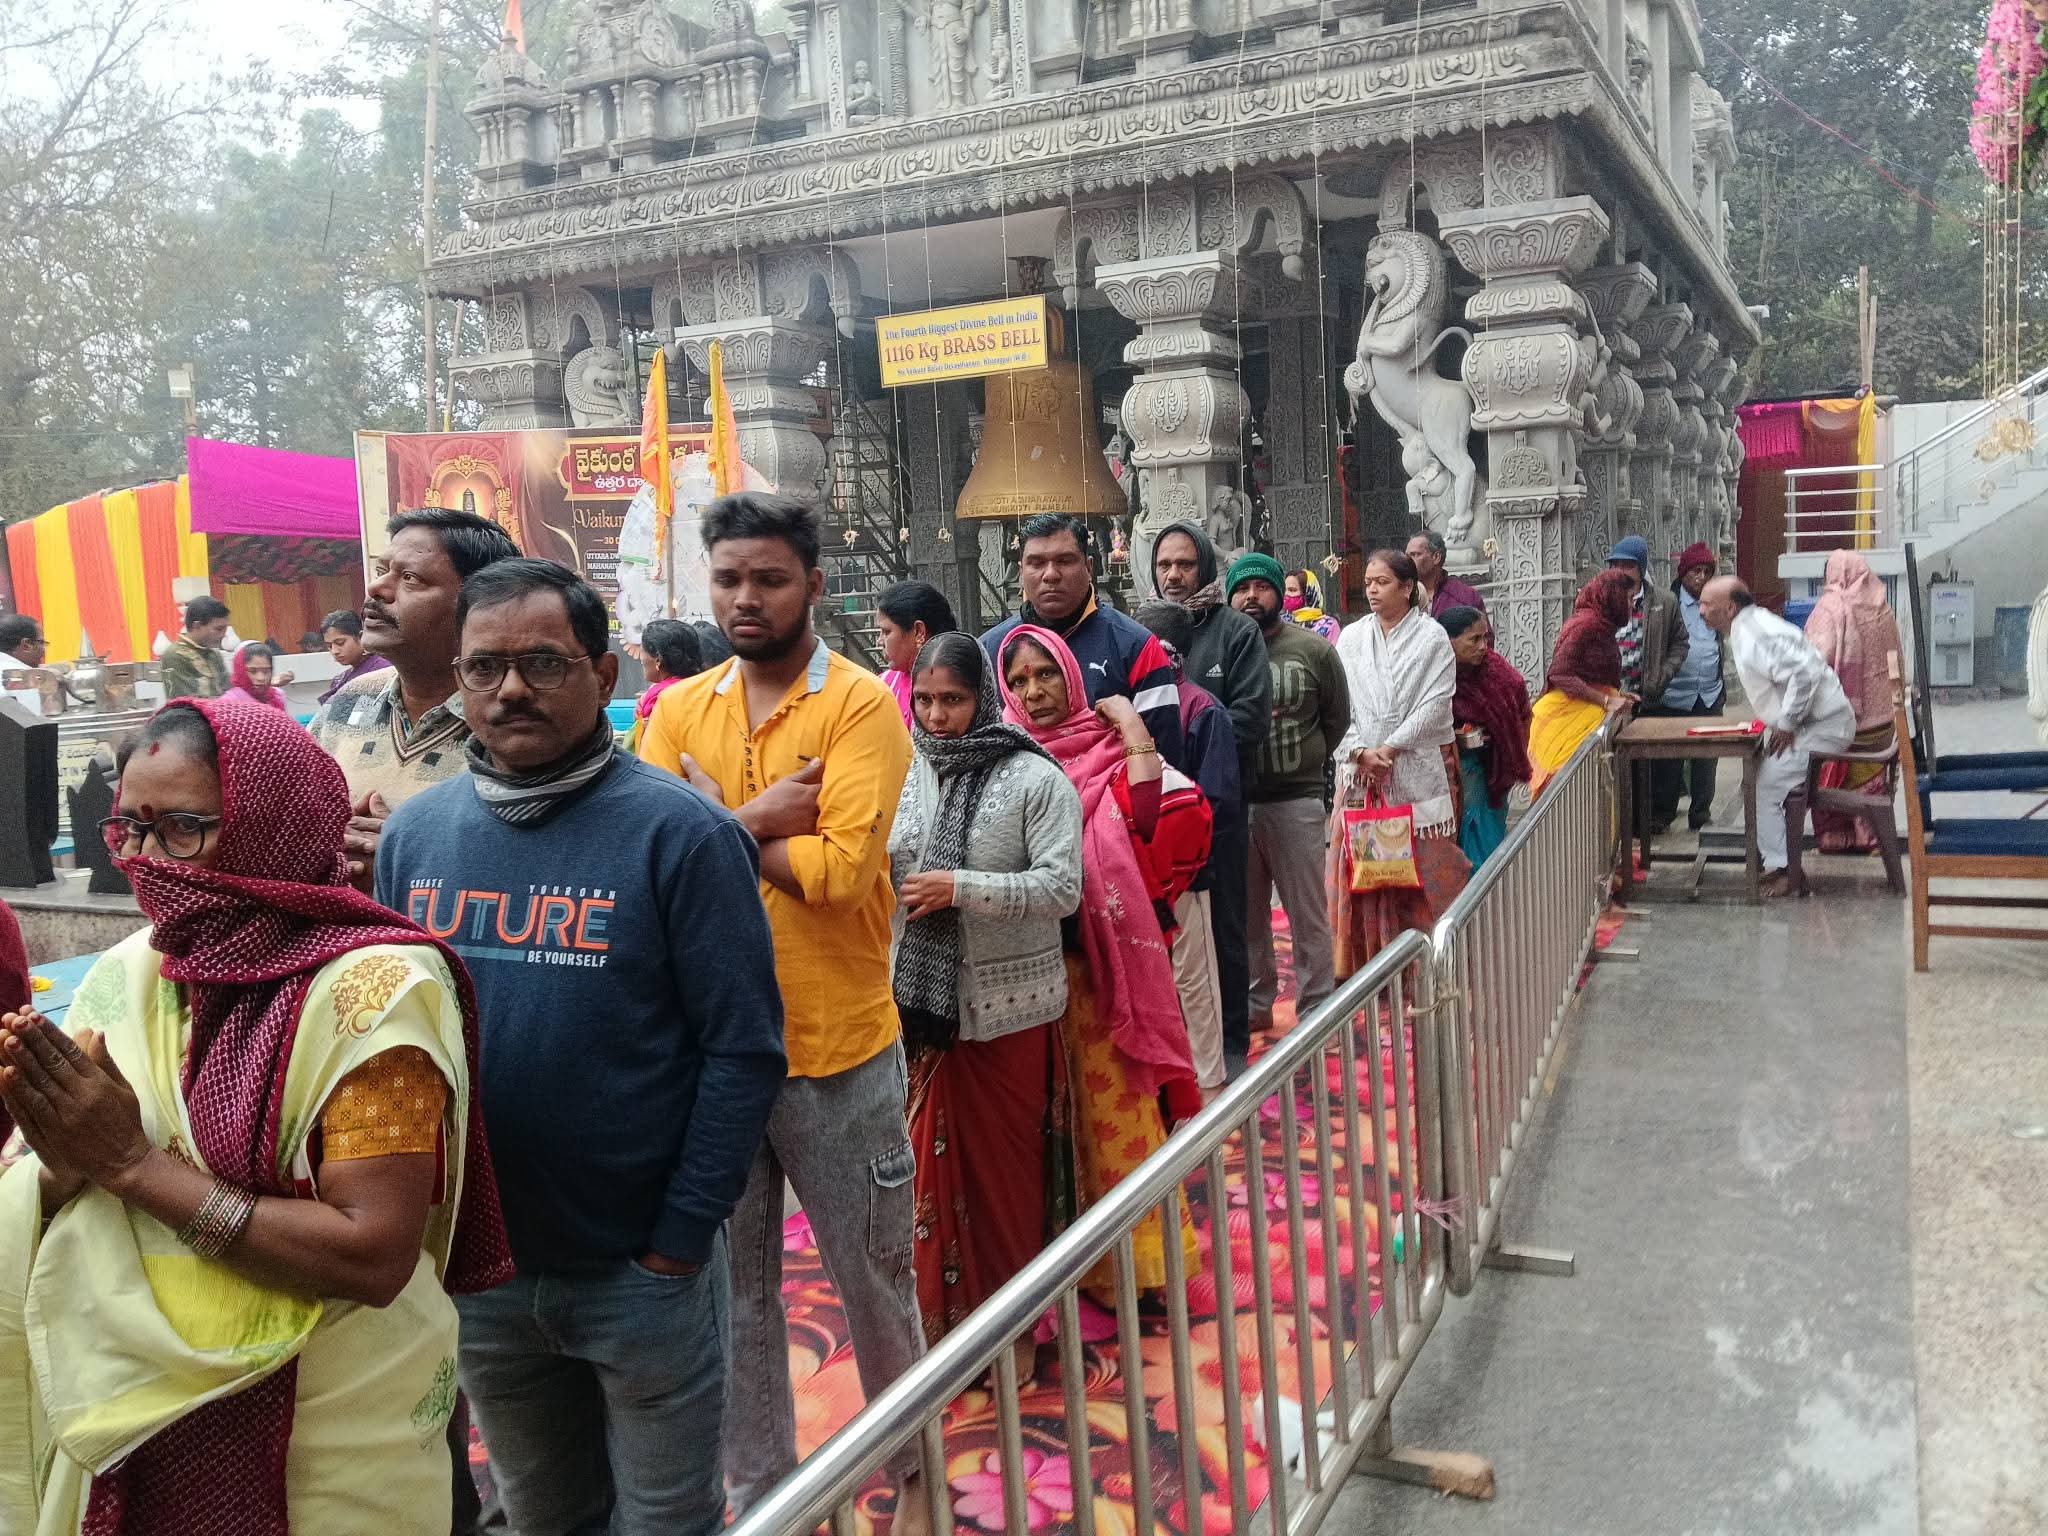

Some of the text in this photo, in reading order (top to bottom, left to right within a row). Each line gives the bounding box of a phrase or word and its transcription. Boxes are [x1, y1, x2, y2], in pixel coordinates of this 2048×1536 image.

[886, 311, 1038, 340] The Fourth Biggest Divine Bell in India
[885, 327, 1041, 363] 1116 Kg BRASS BELL
[409, 878, 616, 900] CREATE YOUR OWN
[408, 888, 615, 950] FUTURE
[527, 950, 608, 968] BE YOURSELF
